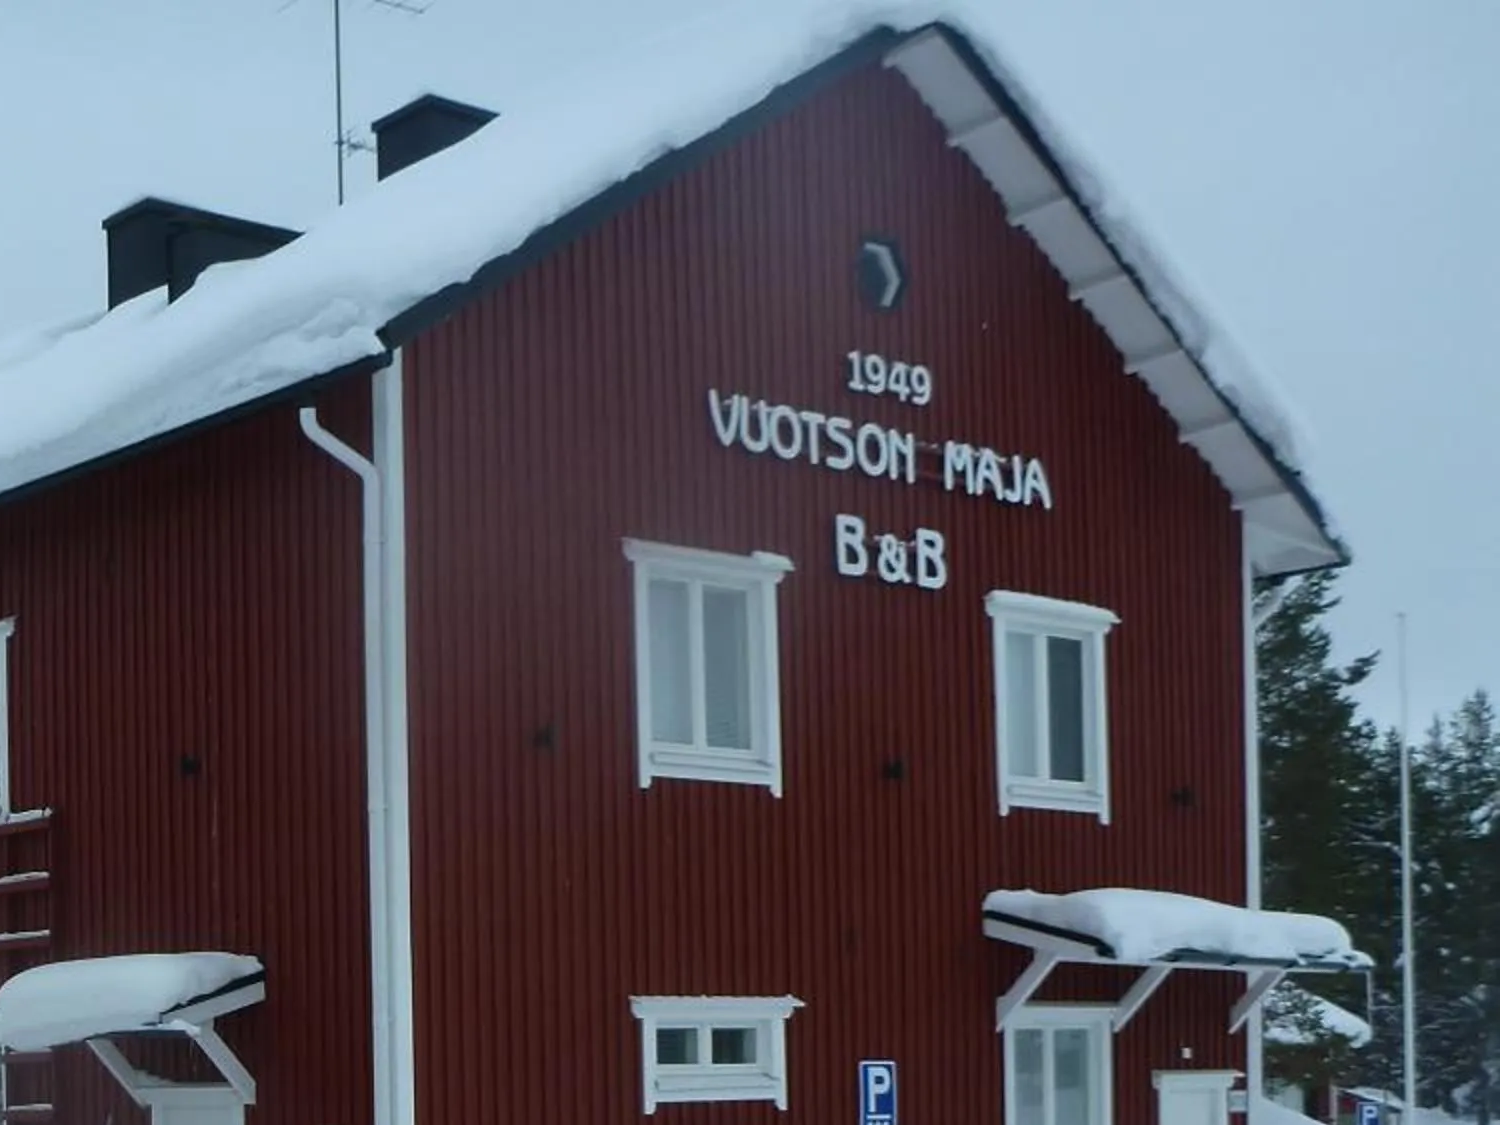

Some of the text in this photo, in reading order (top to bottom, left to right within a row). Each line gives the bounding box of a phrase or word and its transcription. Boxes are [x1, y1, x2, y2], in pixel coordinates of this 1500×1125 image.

[847, 350, 933, 405] 1949
[708, 388, 1053, 509] VUOTSON MAJA
[867, 1065, 891, 1113] P
